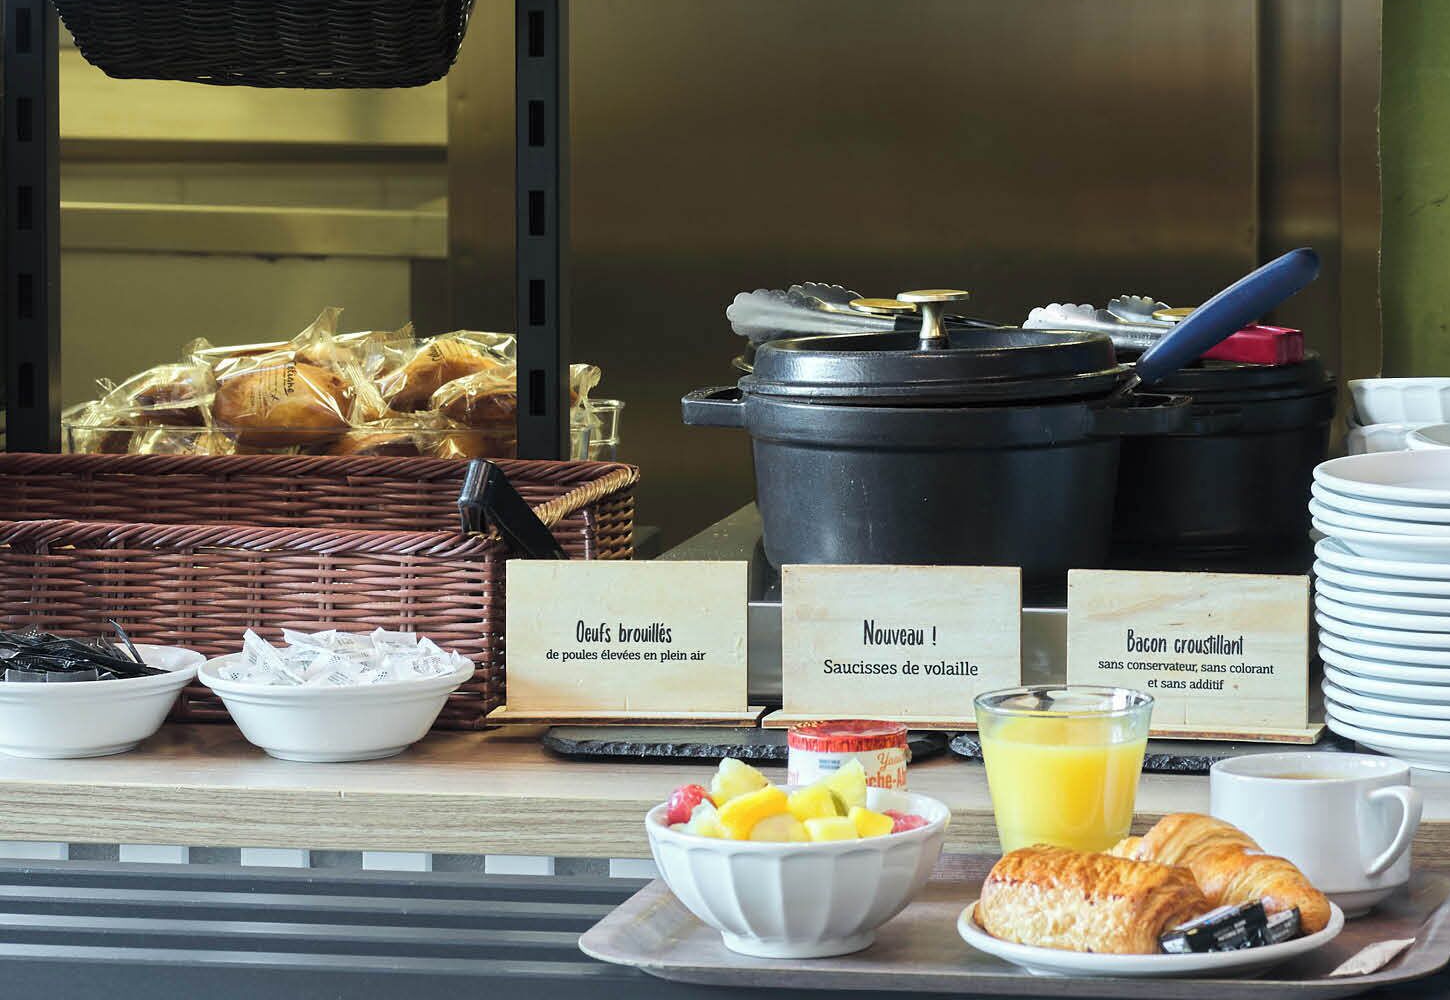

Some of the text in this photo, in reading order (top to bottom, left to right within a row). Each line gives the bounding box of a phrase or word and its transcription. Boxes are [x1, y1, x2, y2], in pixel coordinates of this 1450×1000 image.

[576, 619, 672, 643] Oeufs brouillés
[863, 619, 937, 646] Nouveau !
[1127, 629, 1243, 655] Bacon croustillant
[545, 649, 706, 663] de poules élevées en plein air
[823, 659, 979, 676] Saucisses de volaille
[1098, 660, 1274, 675] sans conservateur, sans colorant
[1147, 678, 1225, 690] et sans additif
